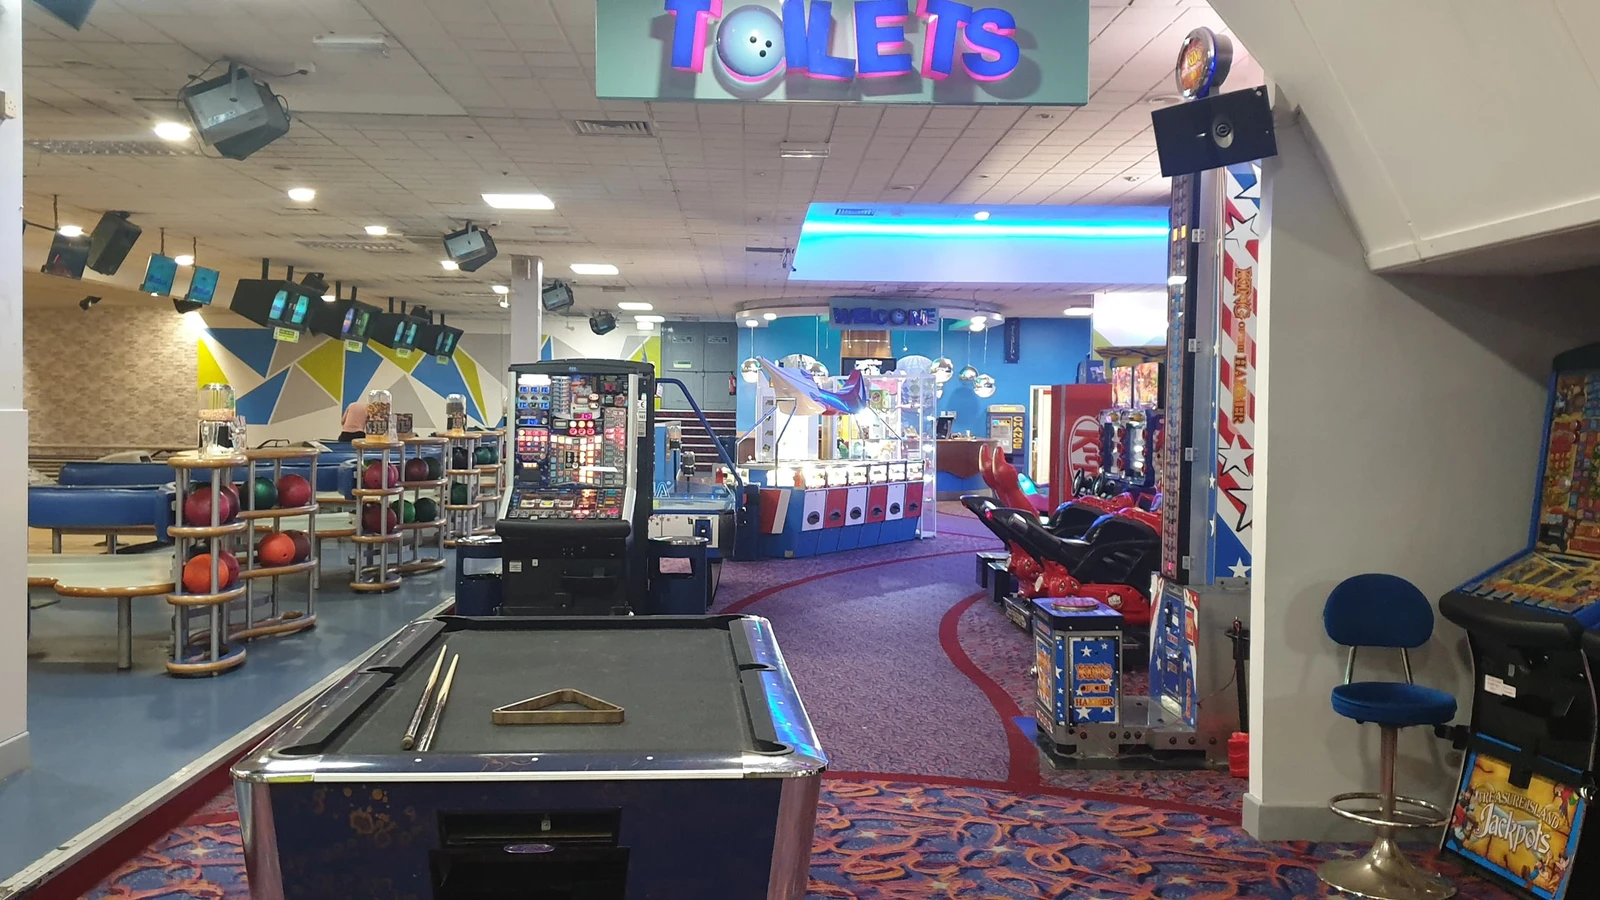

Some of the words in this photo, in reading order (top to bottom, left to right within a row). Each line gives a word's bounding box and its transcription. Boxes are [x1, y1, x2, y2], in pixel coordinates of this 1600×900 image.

[664, 0, 1020, 82] TOILETS
[1233, 267, 1252, 320] KING
[833, 307, 936, 326] WELCOME
[1237, 321, 1246, 333] OF
[1013, 416, 1024, 449] CHANGE
[1076, 664, 1113, 680] KING
[1478, 791, 1526, 808] TREASURE
[1526, 800, 1560, 829] ISLAND
[1478, 803, 1551, 854] Jackpots
